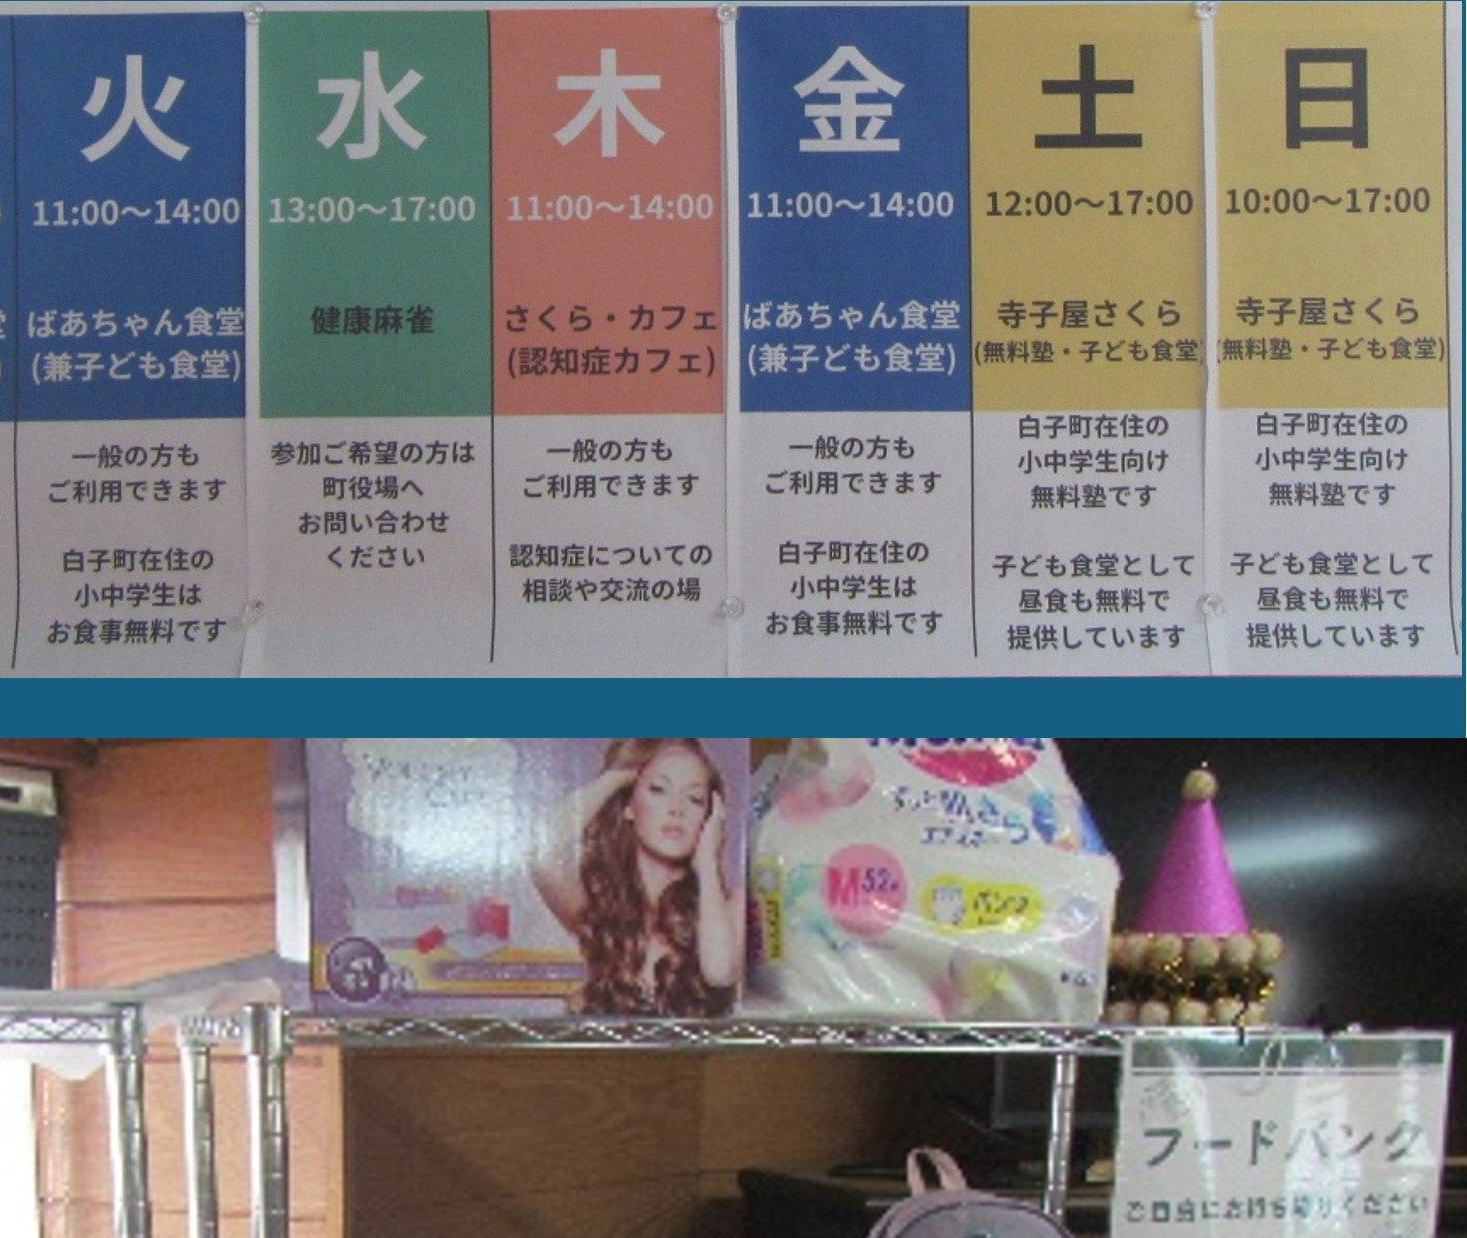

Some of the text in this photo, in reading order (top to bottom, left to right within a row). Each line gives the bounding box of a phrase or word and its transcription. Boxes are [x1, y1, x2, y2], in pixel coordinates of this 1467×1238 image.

[317, 51, 426, 159] 水
[554, 48, 665, 157] 木
[794, 46, 904, 152] 金
[1035, 44, 1142, 148] 土
[1285, 47, 1368, 150] 日
[81, 55, 190, 162] 火
[28, 306, 245, 338] ばあちゃん食堂
[312, 306, 433, 334] 健康麻雀
[506, 305, 716, 332] さくら・カフェ
[742, 299, 961, 331] ばあちゃん食堂
[998, 300, 1180, 328] 寺子屋さくら
[1237, 297, 1418, 326] 寺子屋さくら
[31, 350, 241, 382] (兼子ども食堂)
[508, 346, 715, 378] (認知症カフェ)
[749, 343, 955, 375] (兼子ども食堂)
[1019, 414, 1168, 439] 白子町在住の
[1257, 412, 1407, 436] 白子町在住の
[72, 444, 198, 468] 一般の方も
[272, 441, 474, 465] 参加ご希望の方は
[547, 439, 672, 462] 一般の方も
[790, 435, 914, 459] 一般の方も
[1256, 447, 1407, 471] 小中学生向け
[1018, 449, 1168, 474] 小中学生向け
[49, 479, 225, 503] ご利用できます
[323, 476, 423, 500] 町役場へ
[524, 474, 698, 498] ご利用できます
[766, 471, 941, 494] ご利用できます
[1270, 482, 1395, 506] 無料塾です
[1031, 484, 1156, 508] 無料塾です
[299, 510, 449, 534] お問い合わせ
[63, 548, 213, 572] 白子町在住の
[328, 546, 424, 568] ください
[510, 544, 712, 567] 認知症についての
[779, 541, 929, 564] 白子町在住の
[1231, 552, 1432, 575] 子ども食堂として
[993, 554, 1194, 578] 子ども食堂として
[75, 583, 201, 607] 小中学生は
[523, 578, 700, 602] 相談や交流の場
[791, 575, 916, 599] 小中学生は
[1258, 587, 1407, 611] 昼食も無料で
[1019, 588, 1169, 613] 昼食も無料で
[48, 619, 226, 644] お食事無料です
[767, 611, 942, 635] お食事無料です
[1008, 625, 1184, 650] 提供しています
[1246, 623, 1424, 648] 提供しています
[828, 868, 899, 904] M 52
[1144, 1120, 1422, 1166] フードバンク
